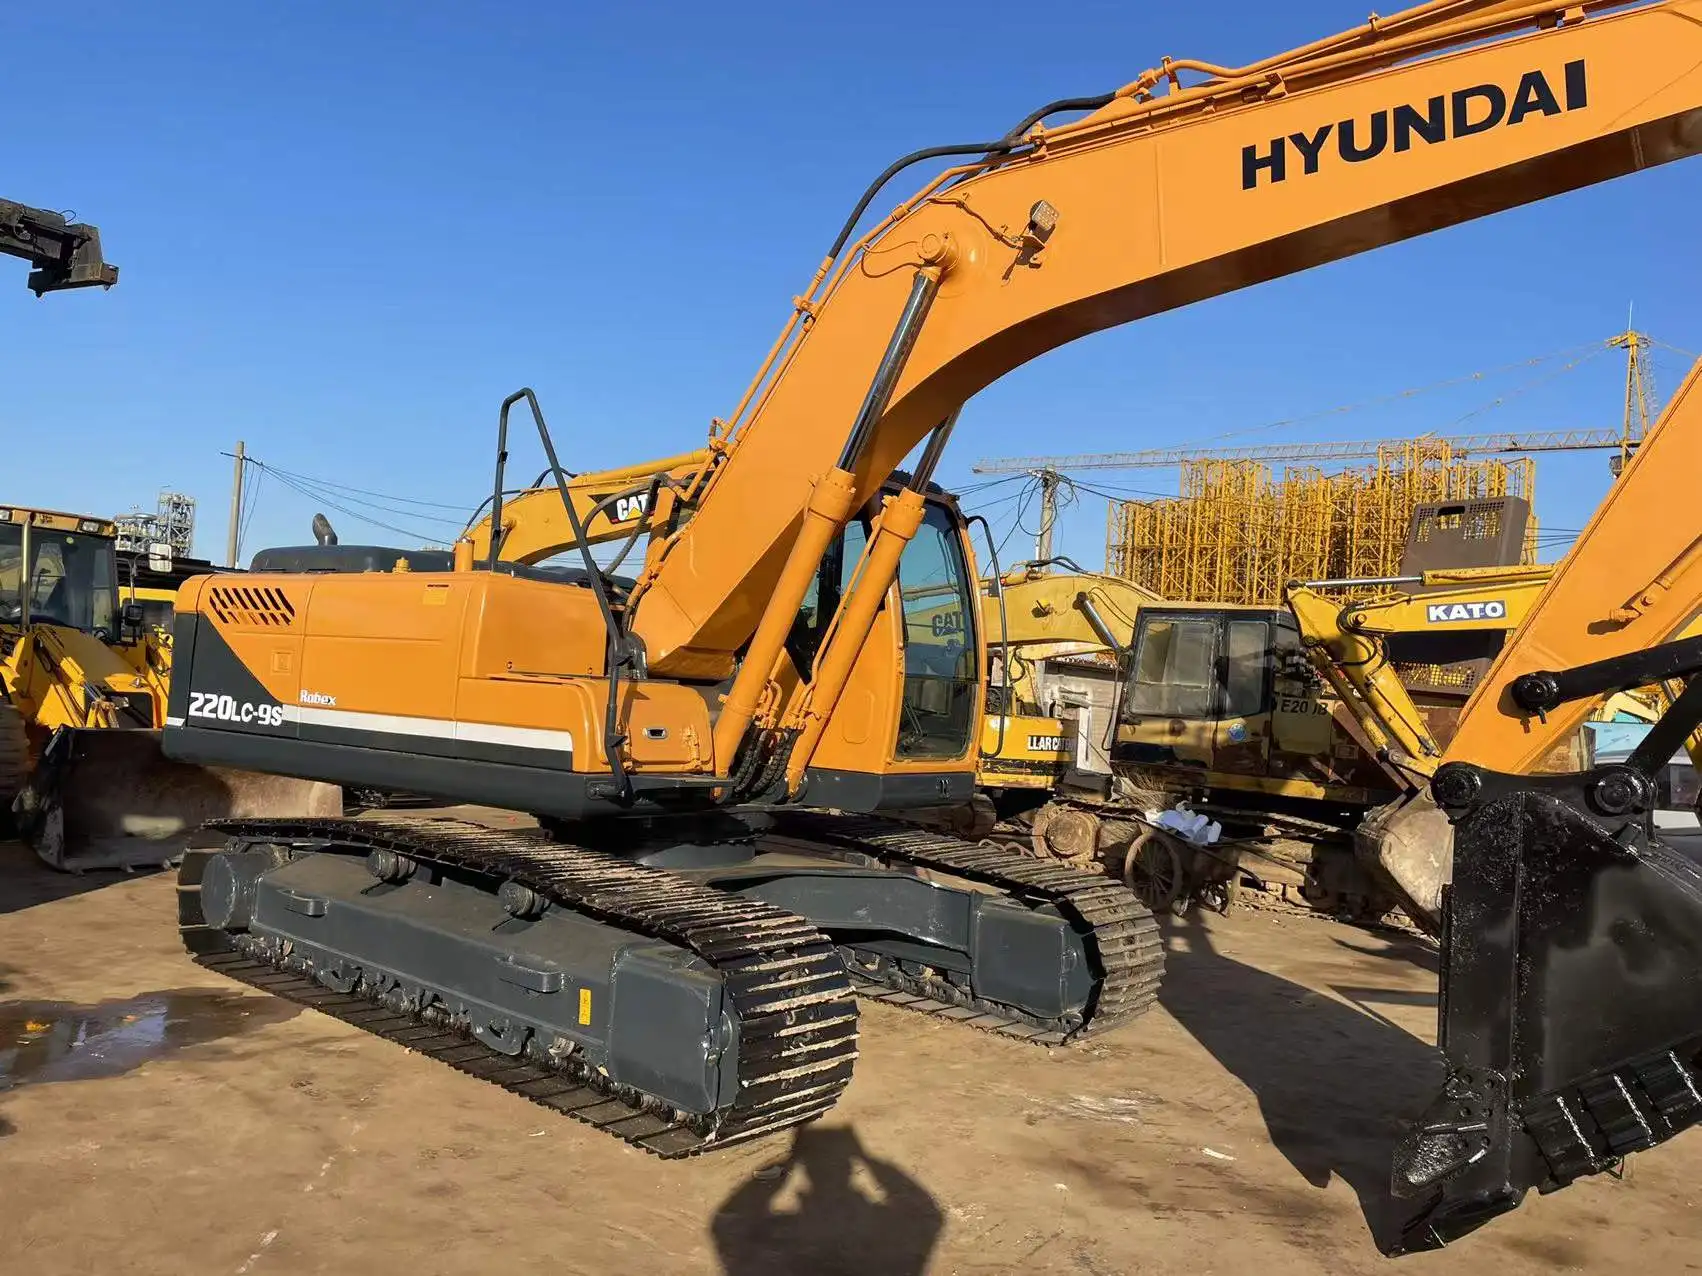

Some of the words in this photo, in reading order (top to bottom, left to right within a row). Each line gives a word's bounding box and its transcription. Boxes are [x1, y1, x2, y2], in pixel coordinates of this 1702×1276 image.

[1242, 59, 1588, 191] HYUNDAI
[616, 493, 649, 521] CAT
[1428, 602, 1504, 621] KATO
[300, 689, 337, 706] Robex
